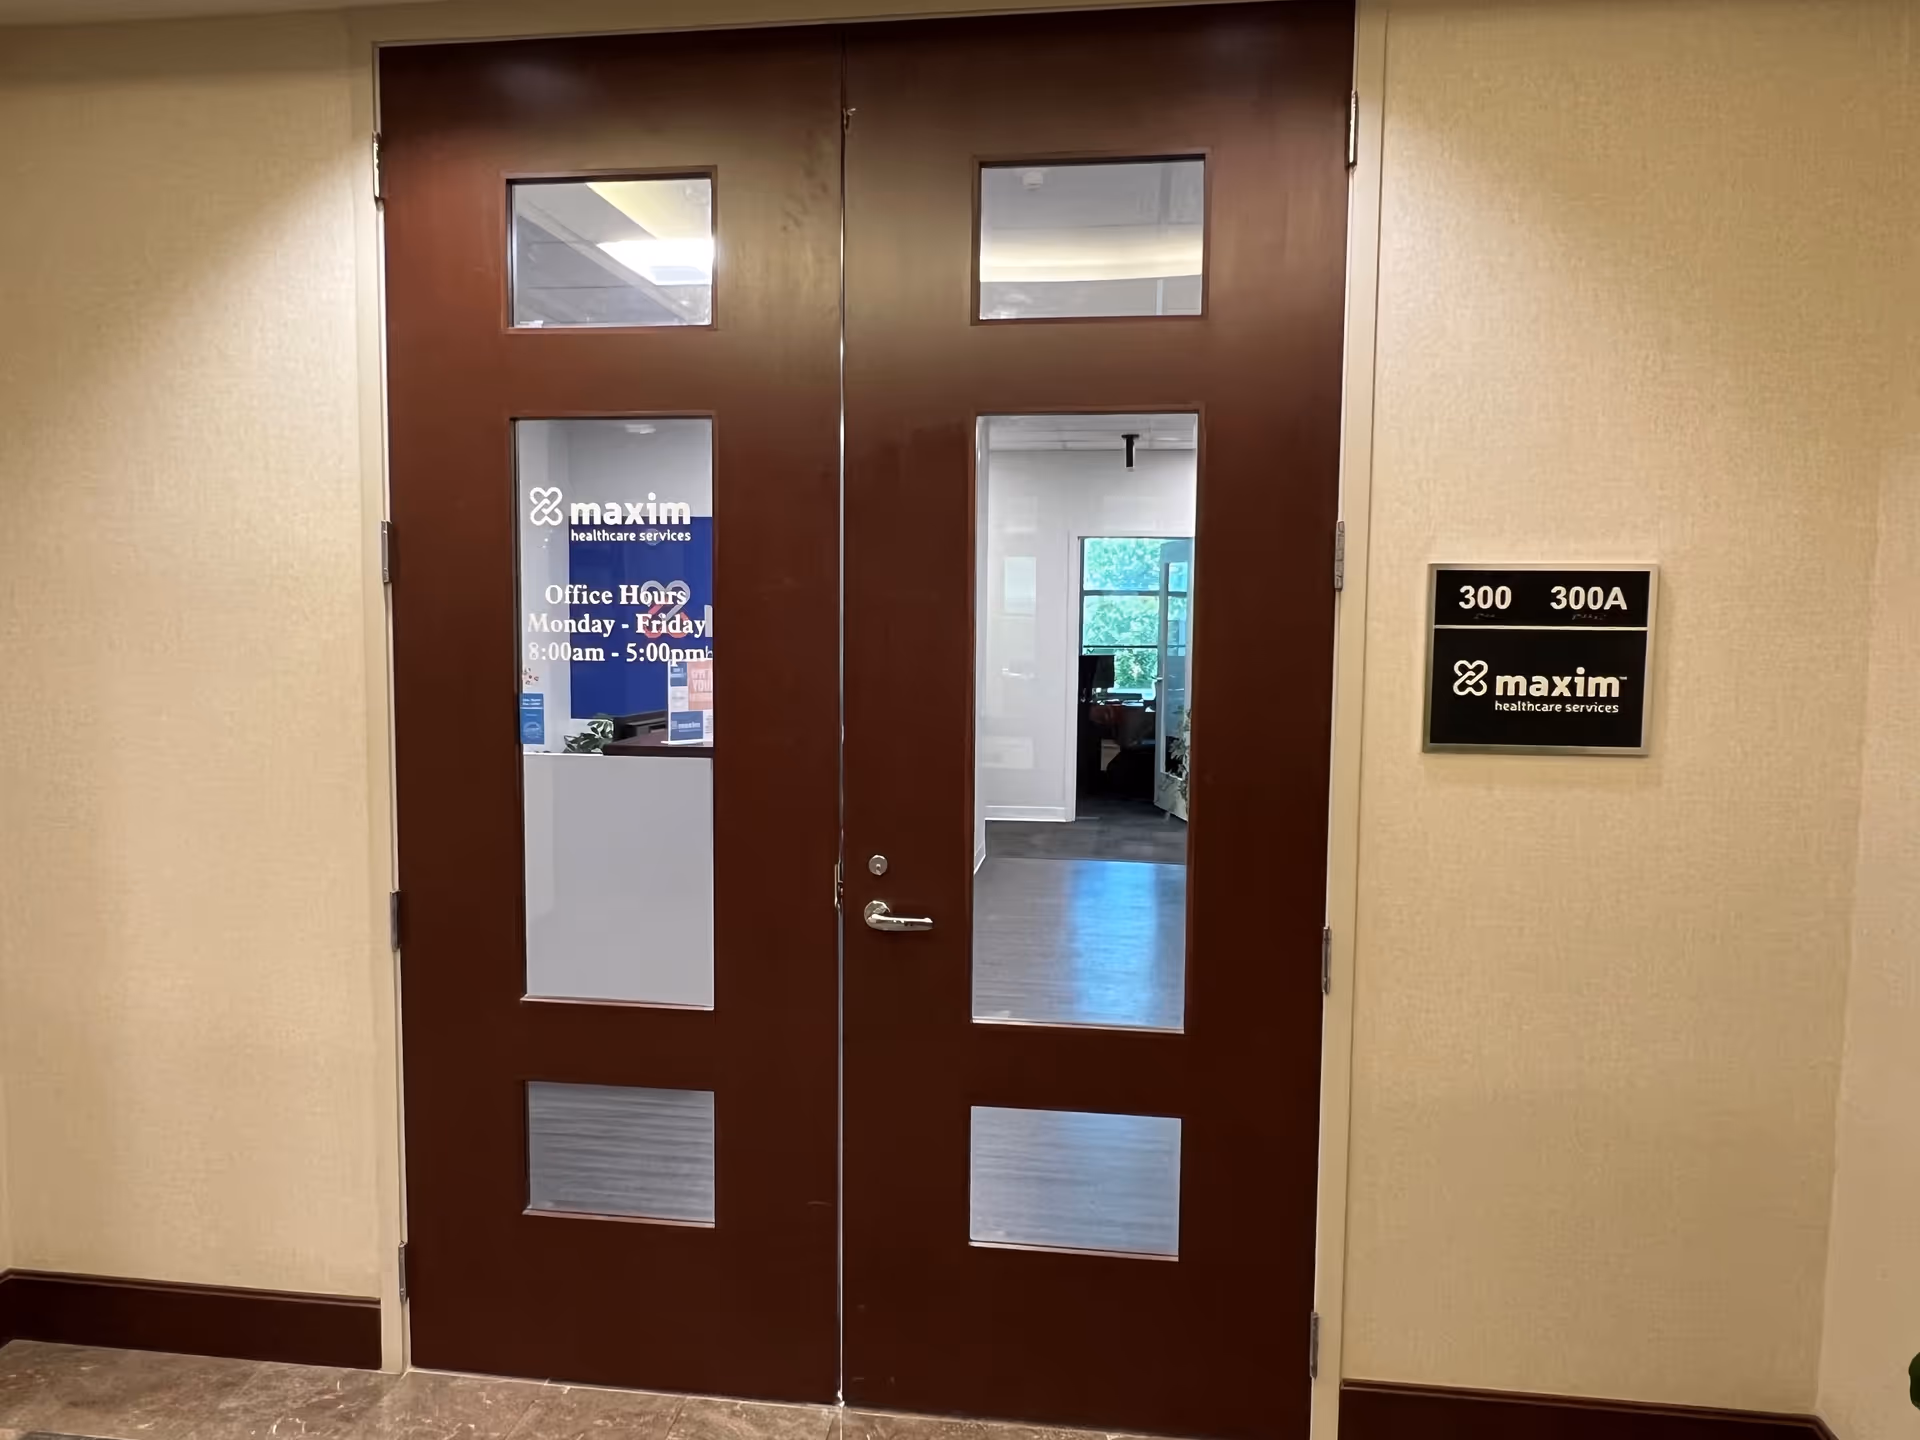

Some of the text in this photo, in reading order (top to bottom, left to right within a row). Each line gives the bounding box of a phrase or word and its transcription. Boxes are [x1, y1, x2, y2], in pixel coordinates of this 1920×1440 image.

[570, 492, 691, 525] maxim
[571, 529, 692, 542] healthcare services
[545, 584, 687, 605] Office Hours
[1458, 585, 1628, 611] 300 300A
[527, 613, 615, 638] Monday
[635, 613, 706, 638] Friday
[528, 642, 605, 662] 8:00am
[626, 642, 706, 667] 5:00pm
[1495, 666, 1620, 697] maxim
[1495, 700, 1620, 713] healthcare services
